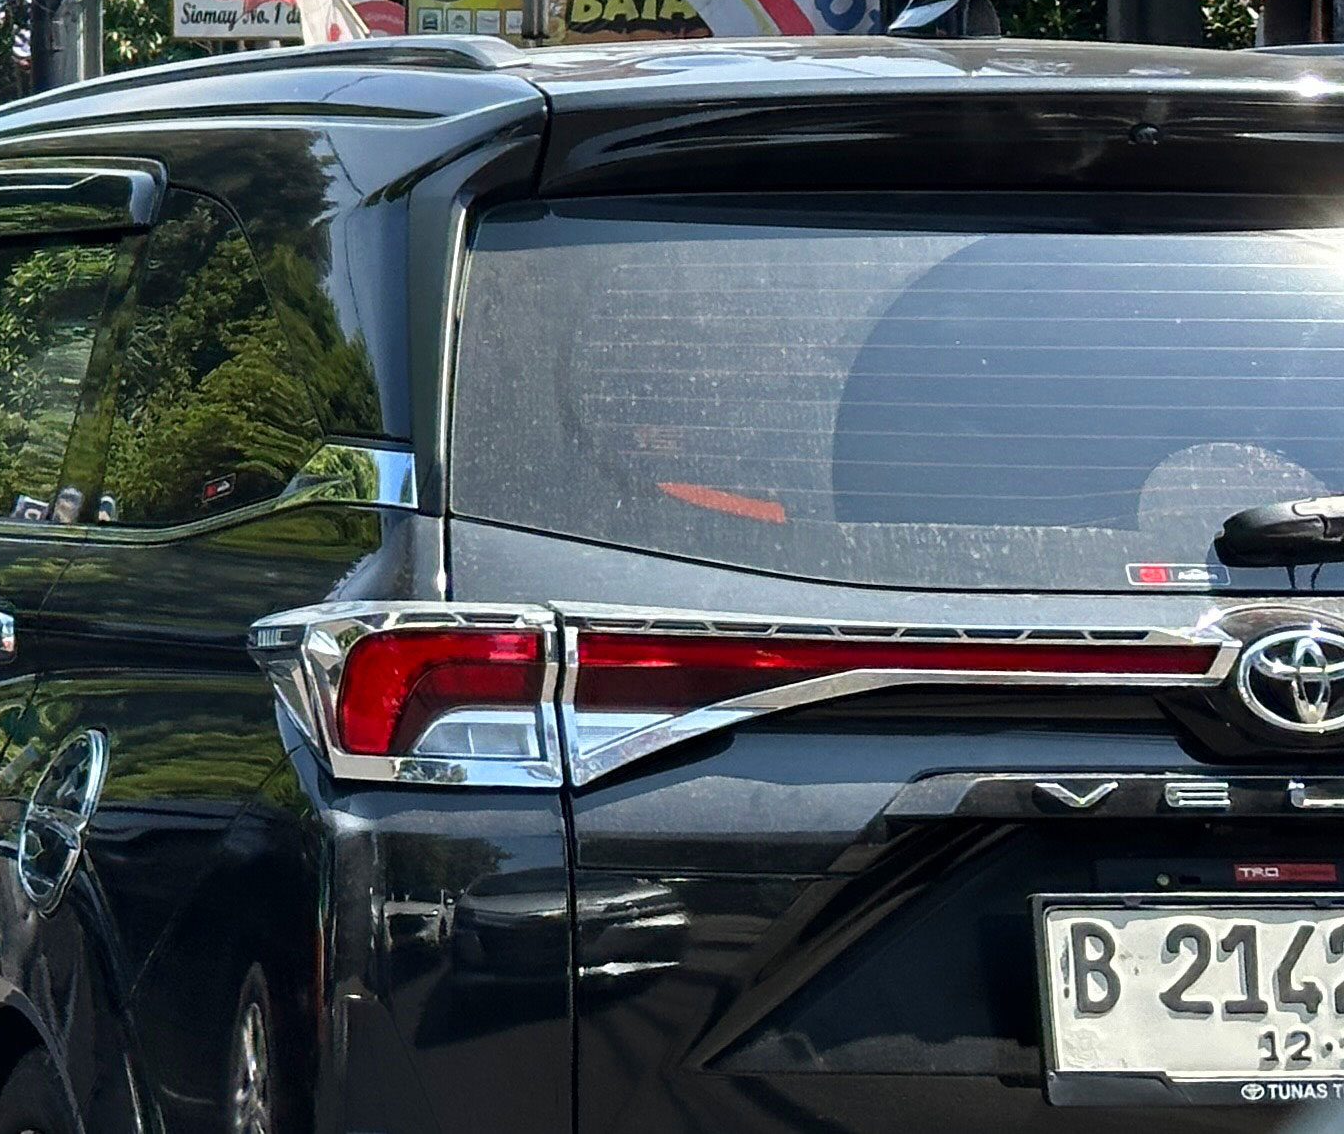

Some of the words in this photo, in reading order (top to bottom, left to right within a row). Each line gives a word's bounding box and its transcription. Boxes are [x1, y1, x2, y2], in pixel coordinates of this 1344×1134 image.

[181, 2, 237, 32] Siomay
[1071, 921, 1120, 1013] B
[1267, 1083, 1327, 1101] TUNAS
